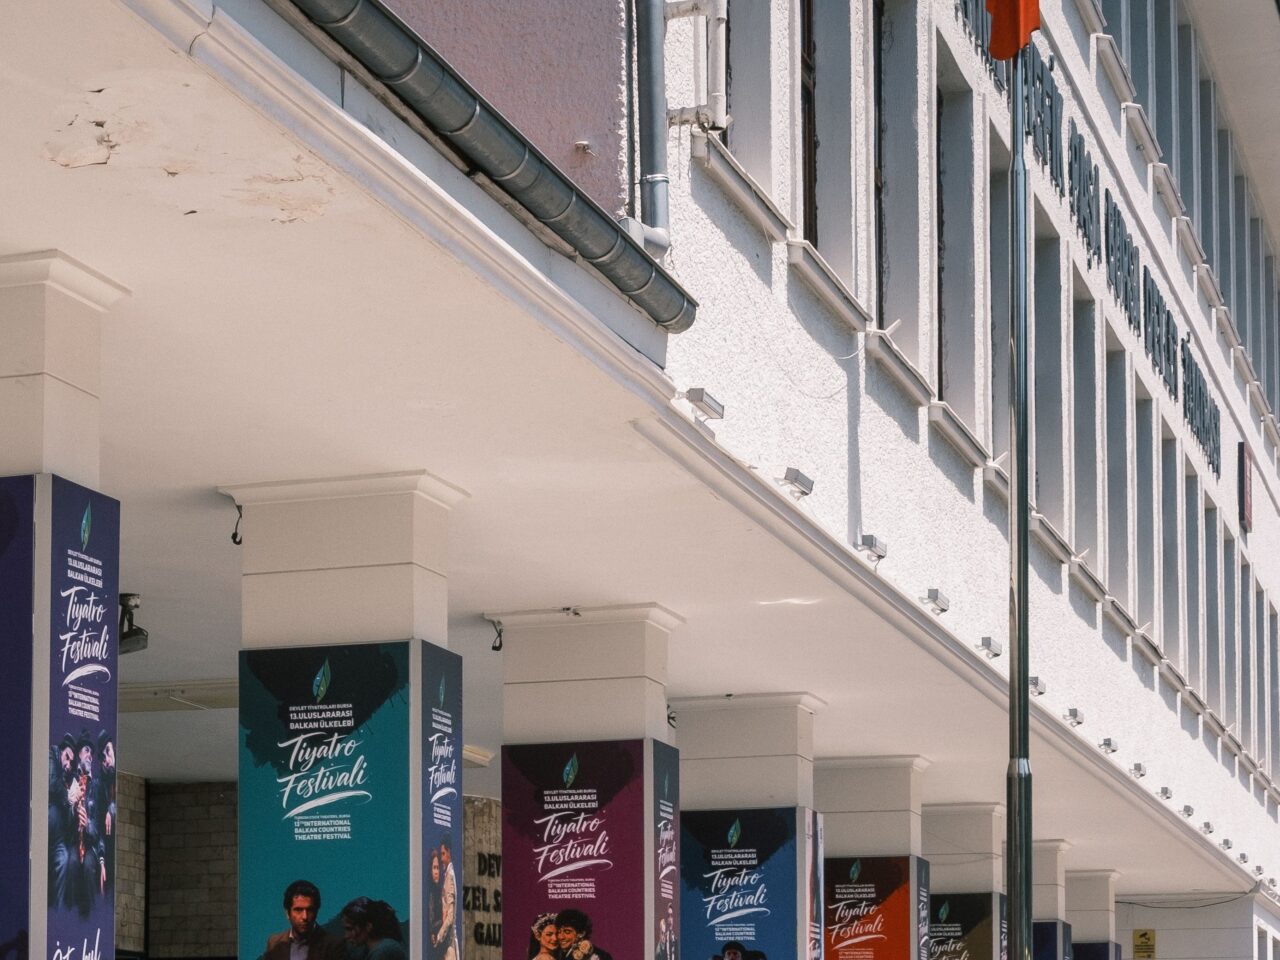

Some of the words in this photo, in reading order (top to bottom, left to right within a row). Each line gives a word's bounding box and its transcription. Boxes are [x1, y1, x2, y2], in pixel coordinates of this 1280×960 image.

[60, 586, 106, 631] Tiyatro
[59, 625, 109, 672] Festivali
[277, 732, 363, 771] Tiyatro
[428, 733, 454, 765] Tiyatro
[277, 755, 367, 808] Festivali
[534, 811, 606, 843] Tiyatro
[533, 830, 609, 873] Festivali
[703, 867, 765, 894] Tiyatro
[702, 884, 768, 919] Festivali
[828, 900, 881, 922] Tiyatro
[827, 914, 884, 944] Festivali
